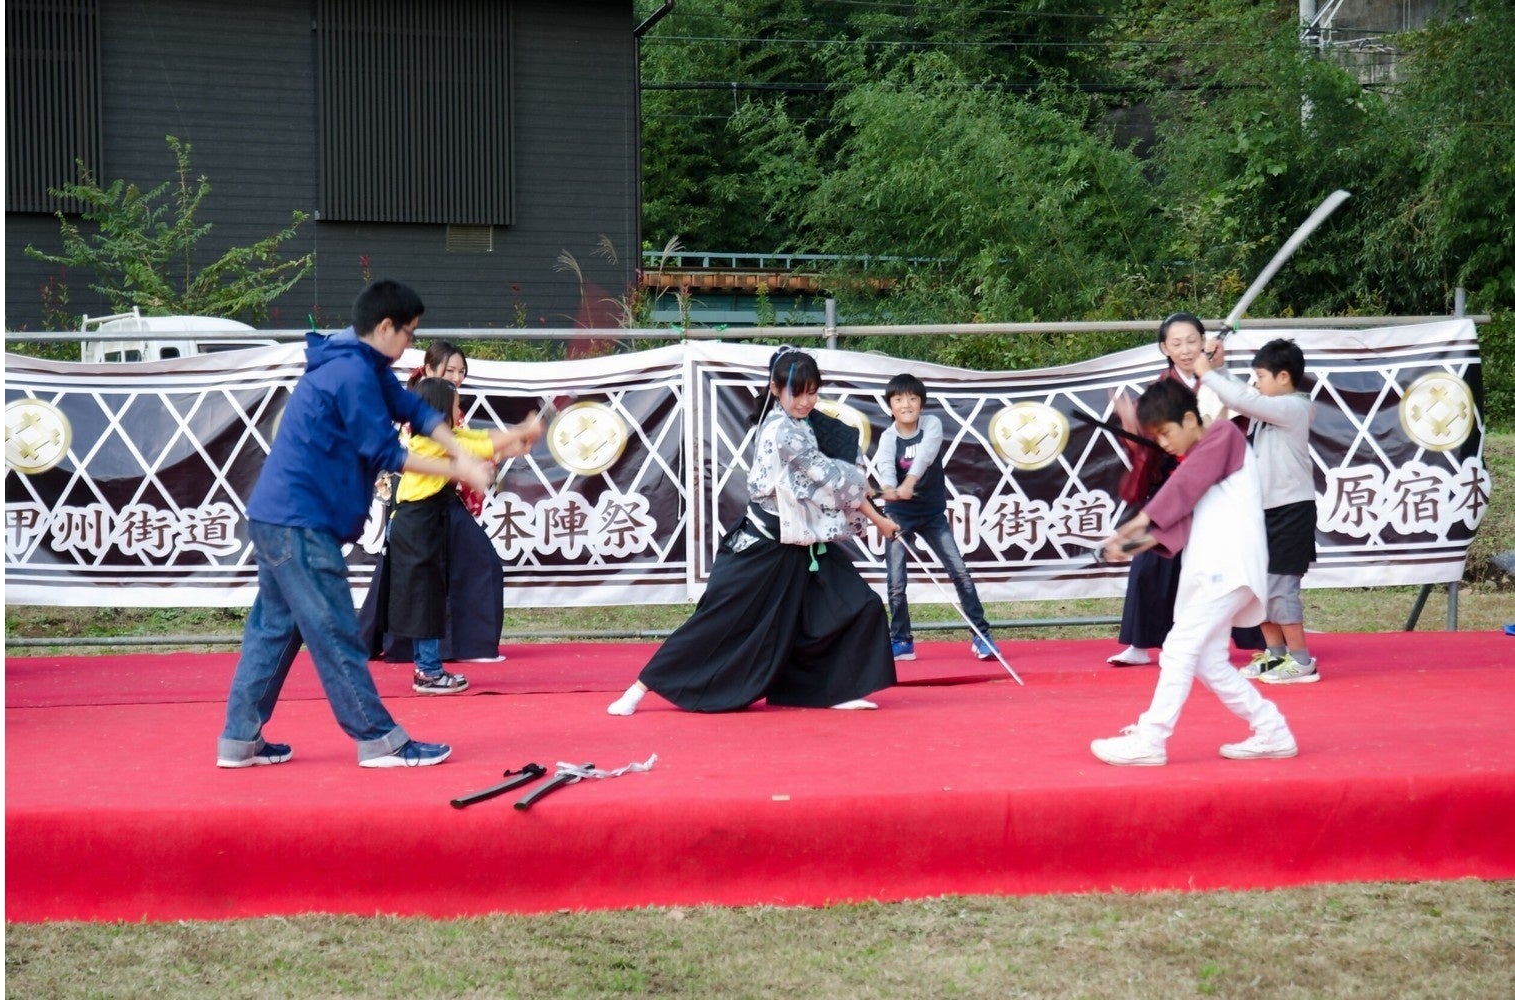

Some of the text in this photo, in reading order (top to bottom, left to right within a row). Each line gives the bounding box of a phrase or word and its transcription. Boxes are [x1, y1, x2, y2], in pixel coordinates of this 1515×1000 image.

[4, 507, 236, 551] 甲州街道
[875, 496, 1112, 547] 州街道
